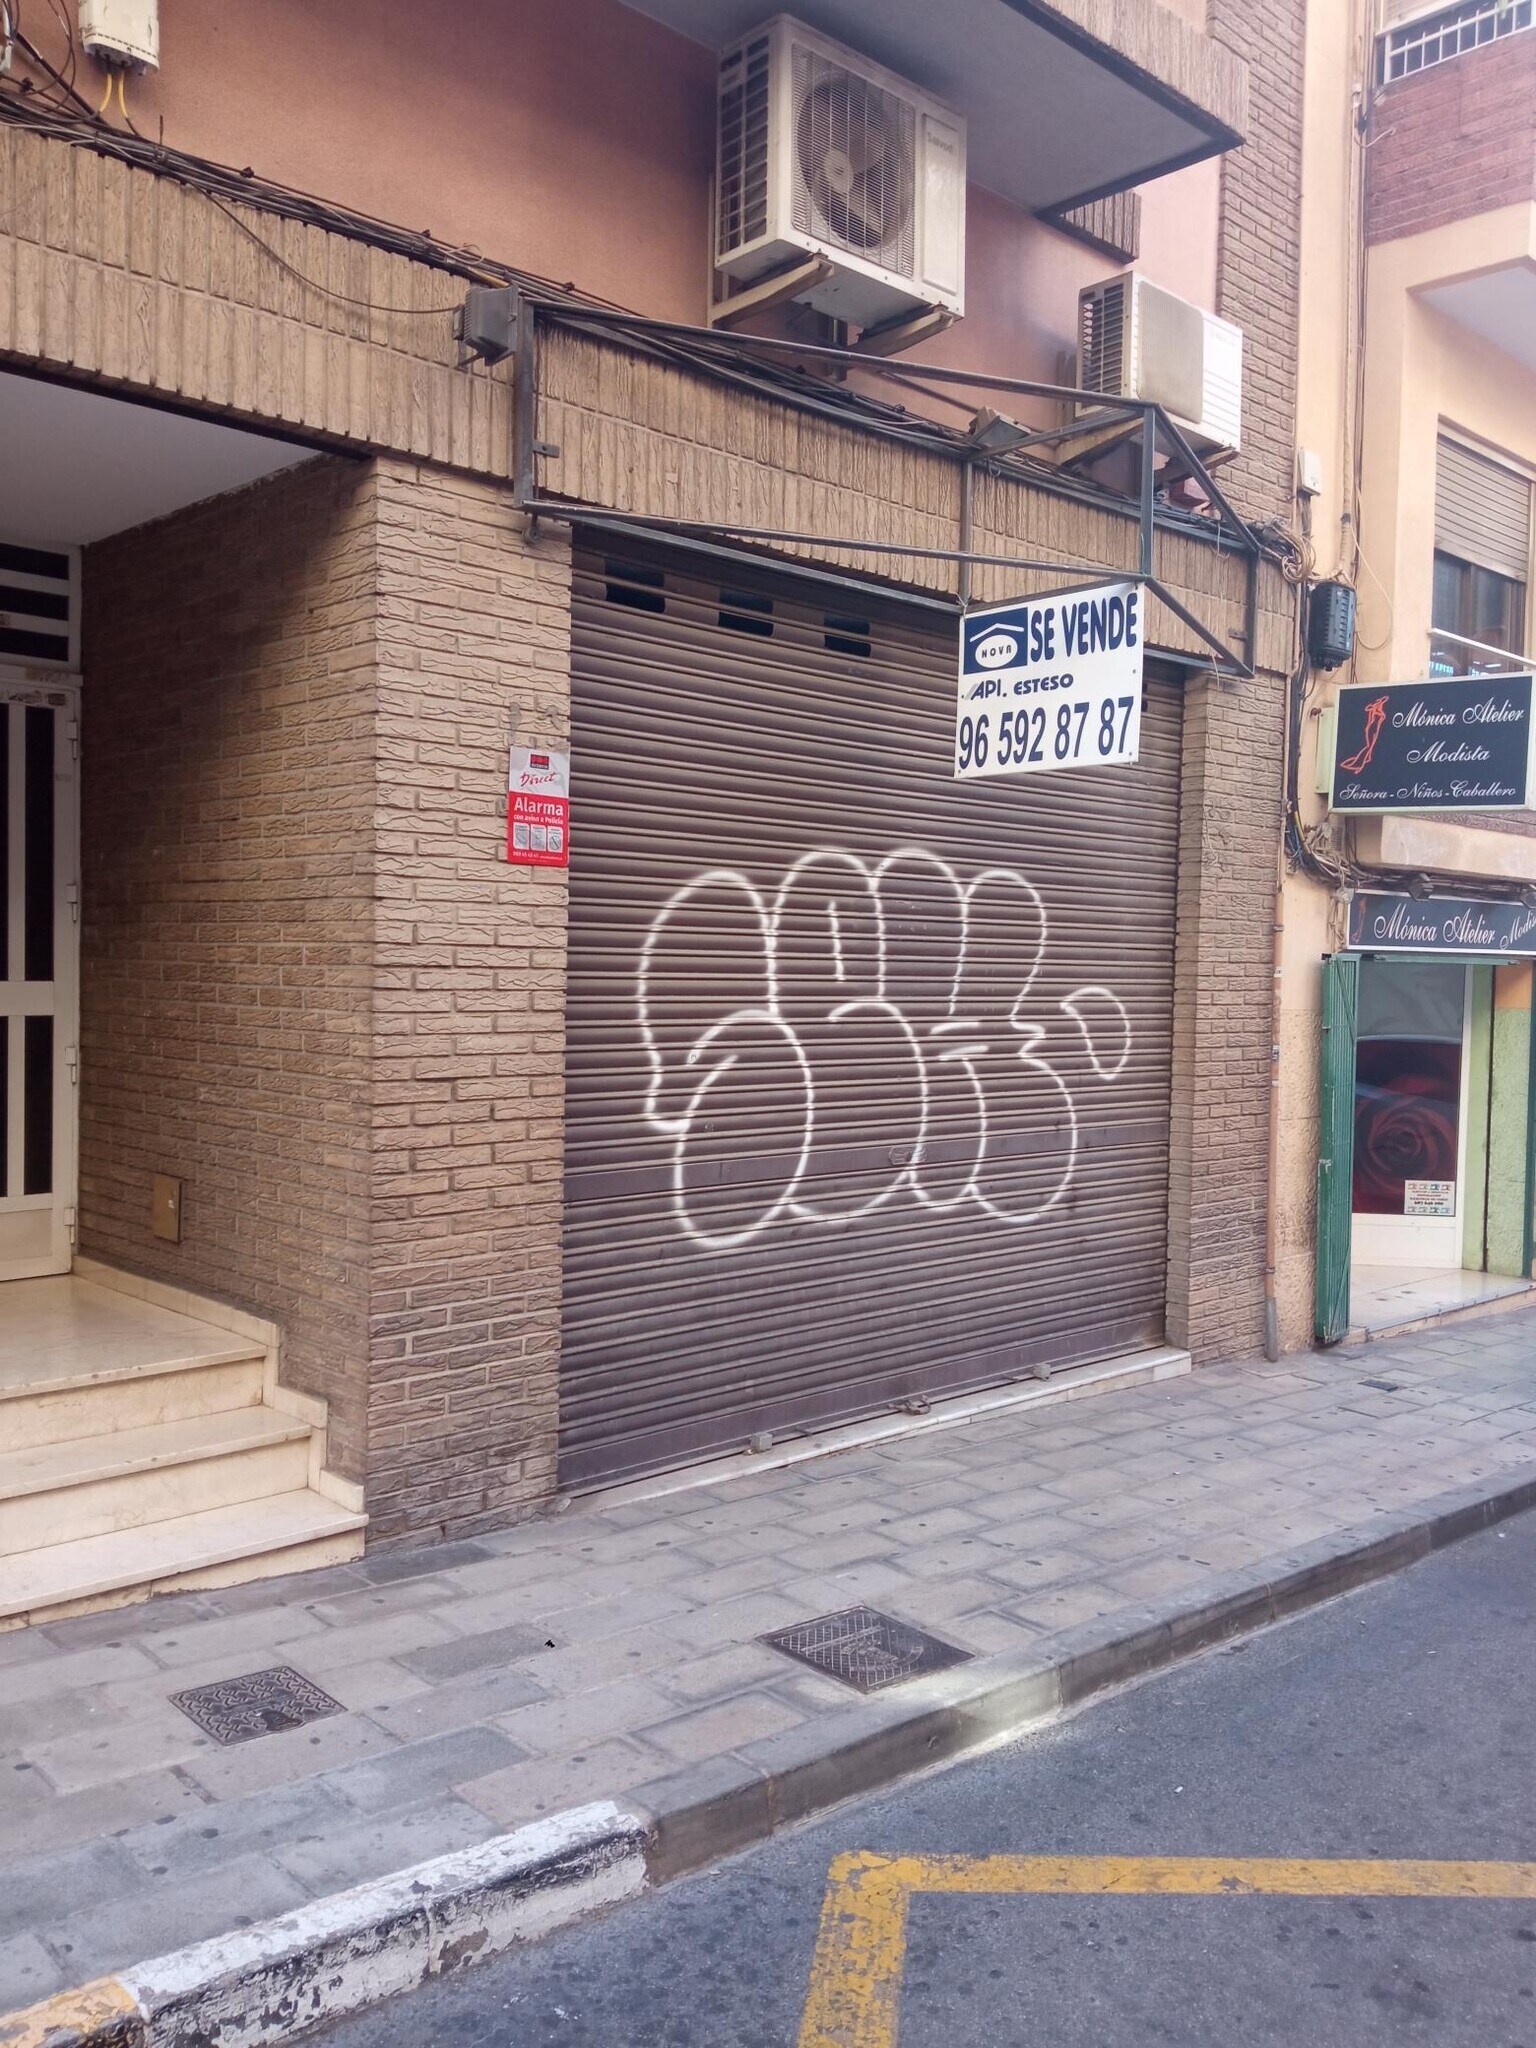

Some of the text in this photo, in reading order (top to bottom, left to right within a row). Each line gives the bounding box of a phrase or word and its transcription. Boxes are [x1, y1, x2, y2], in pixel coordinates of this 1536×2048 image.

[1030, 592, 1138, 662] SE VENDE
[981, 644, 1012, 658] NOVA
[1013, 673, 1074, 695] ESTESO
[1392, 696, 1525, 728] Mónica Atelier
[958, 696, 1135, 770] 96 592 87 87
[1406, 740, 1490, 764] Modista
[520, 771, 557, 787] Direct
[1339, 782, 1387, 800] Señora
[1396, 781, 1443, 799] Niños
[1450, 780, 1516, 798] Caballero
[514, 797, 564, 816] Alarma
[1374, 902, 1437, 941] Mónica
[1442, 908, 1496, 944] Atelier
